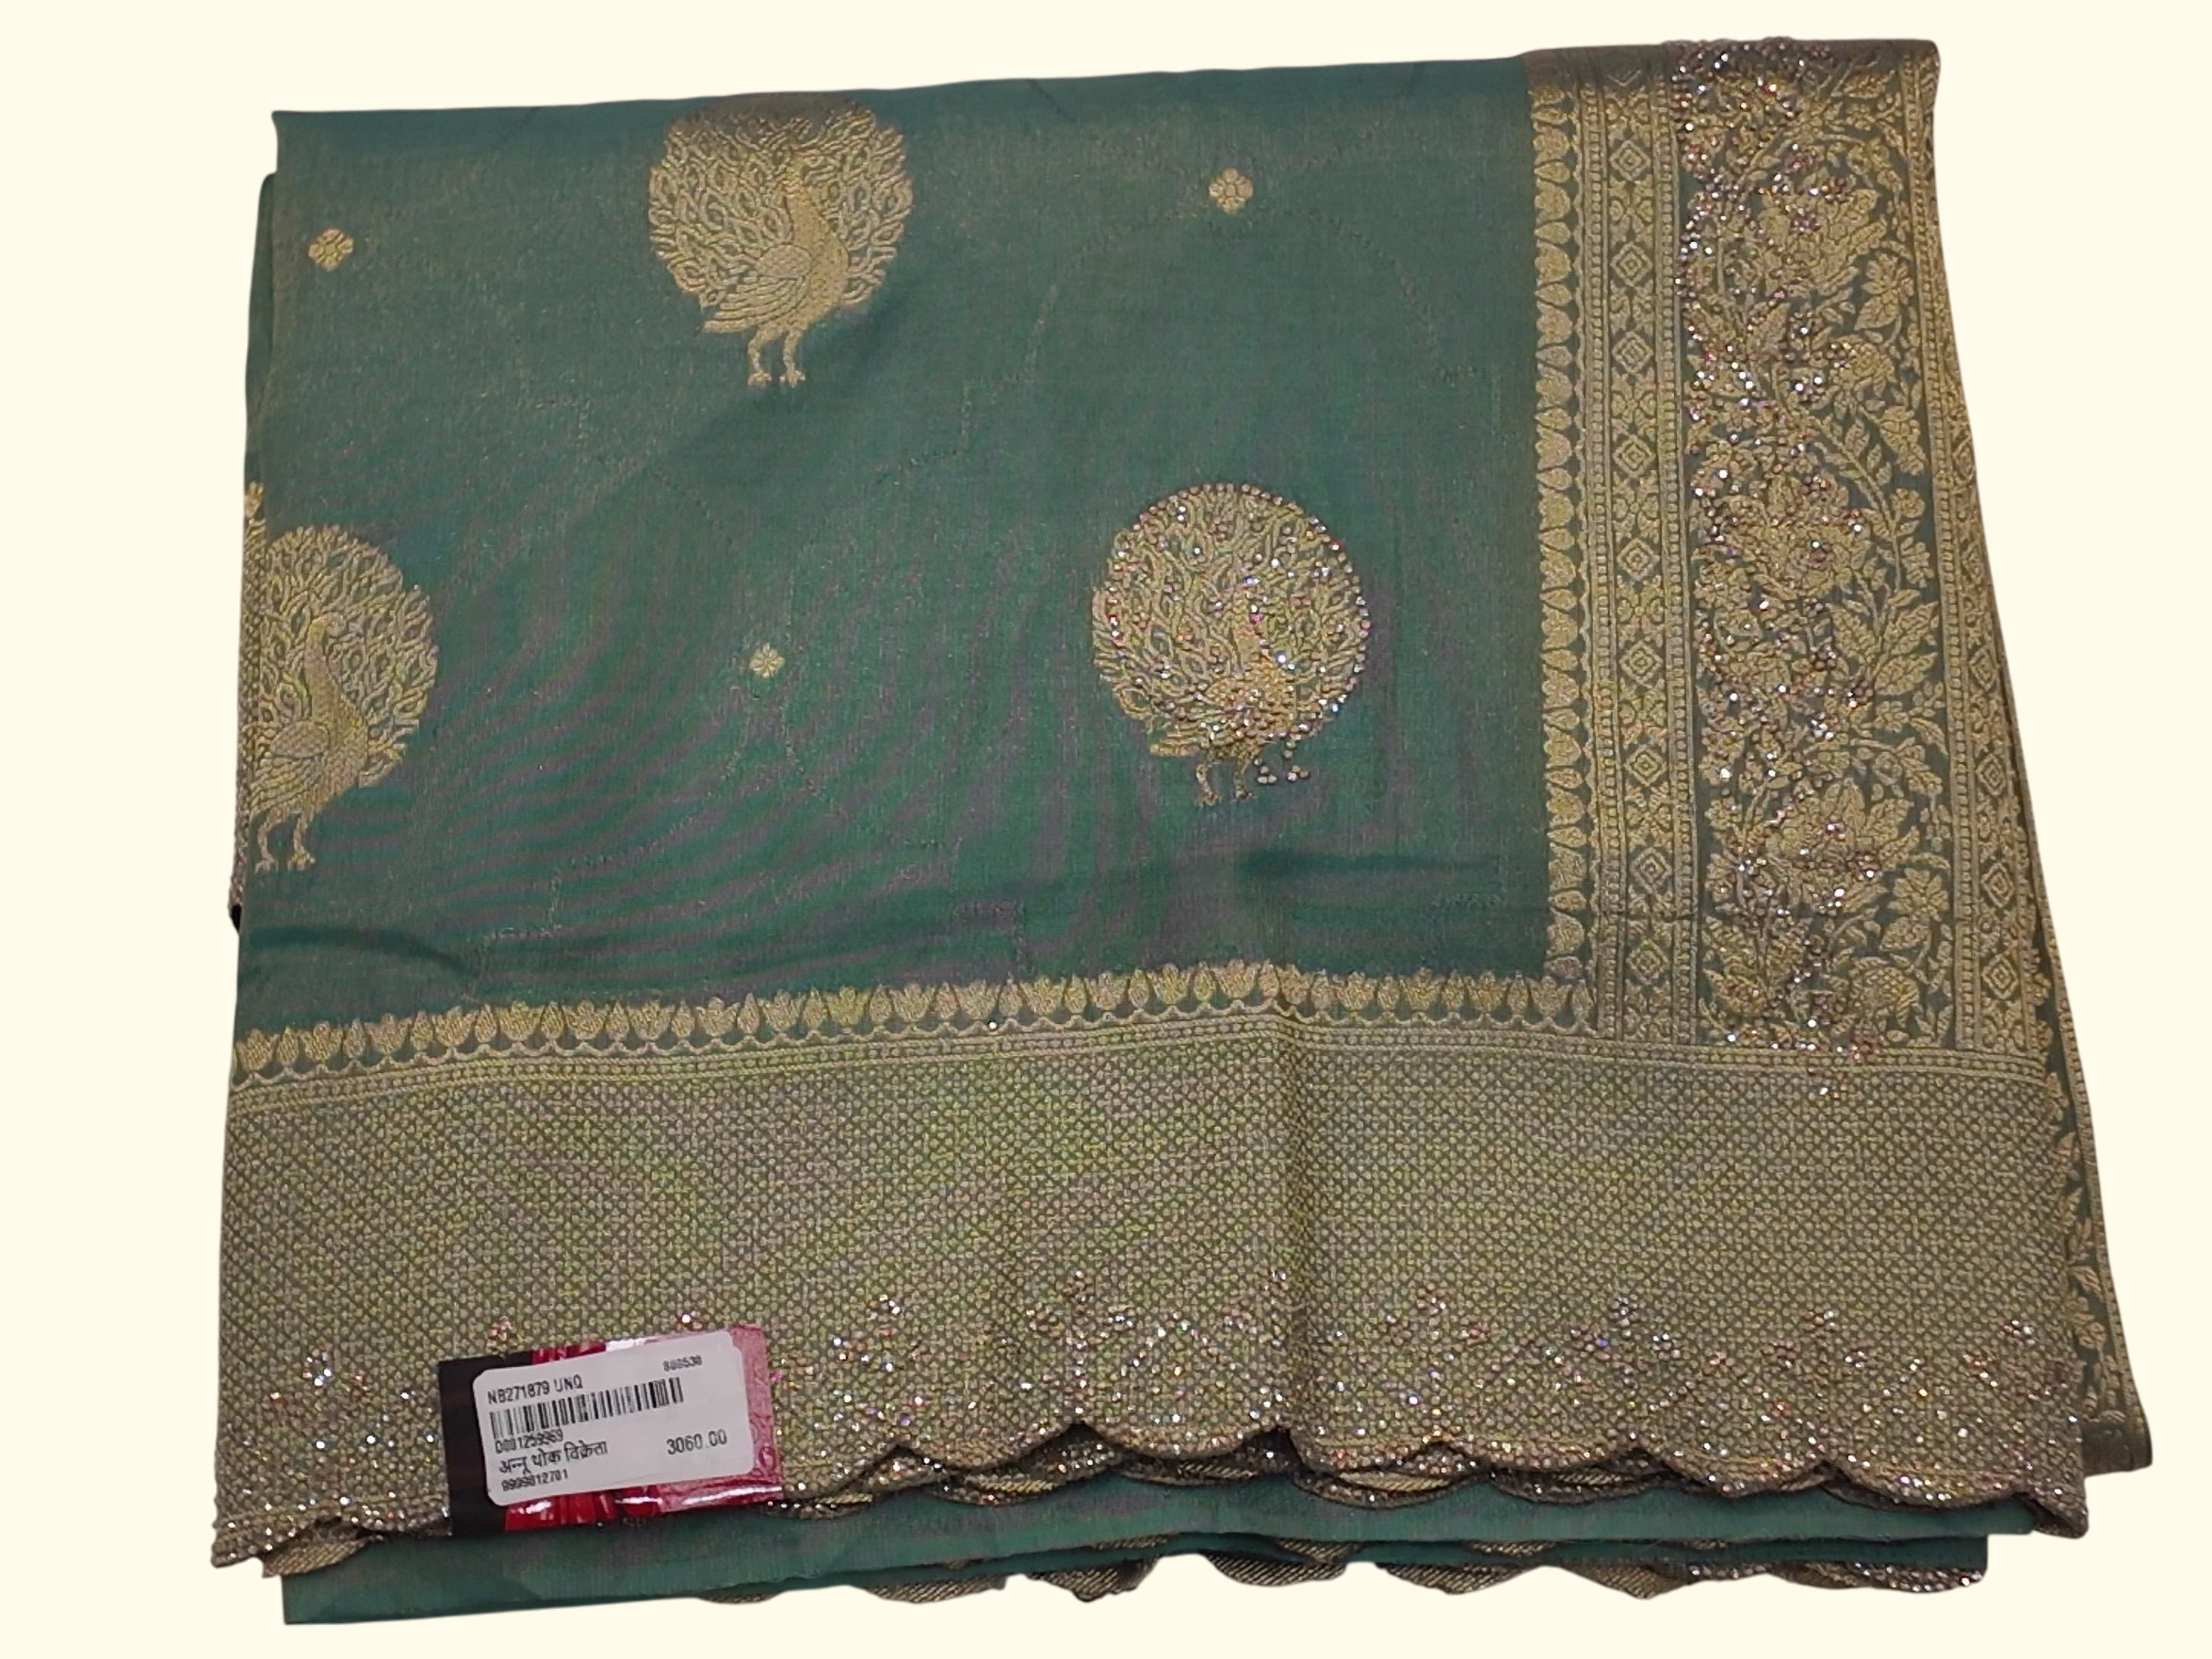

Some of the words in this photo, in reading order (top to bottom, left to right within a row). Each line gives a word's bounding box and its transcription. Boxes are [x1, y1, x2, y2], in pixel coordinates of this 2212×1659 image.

[553, 1374, 583, 1392] UNQ
[563, 1439, 608, 1462] विक्रेता
[666, 1428, 728, 1456] 3060.00
